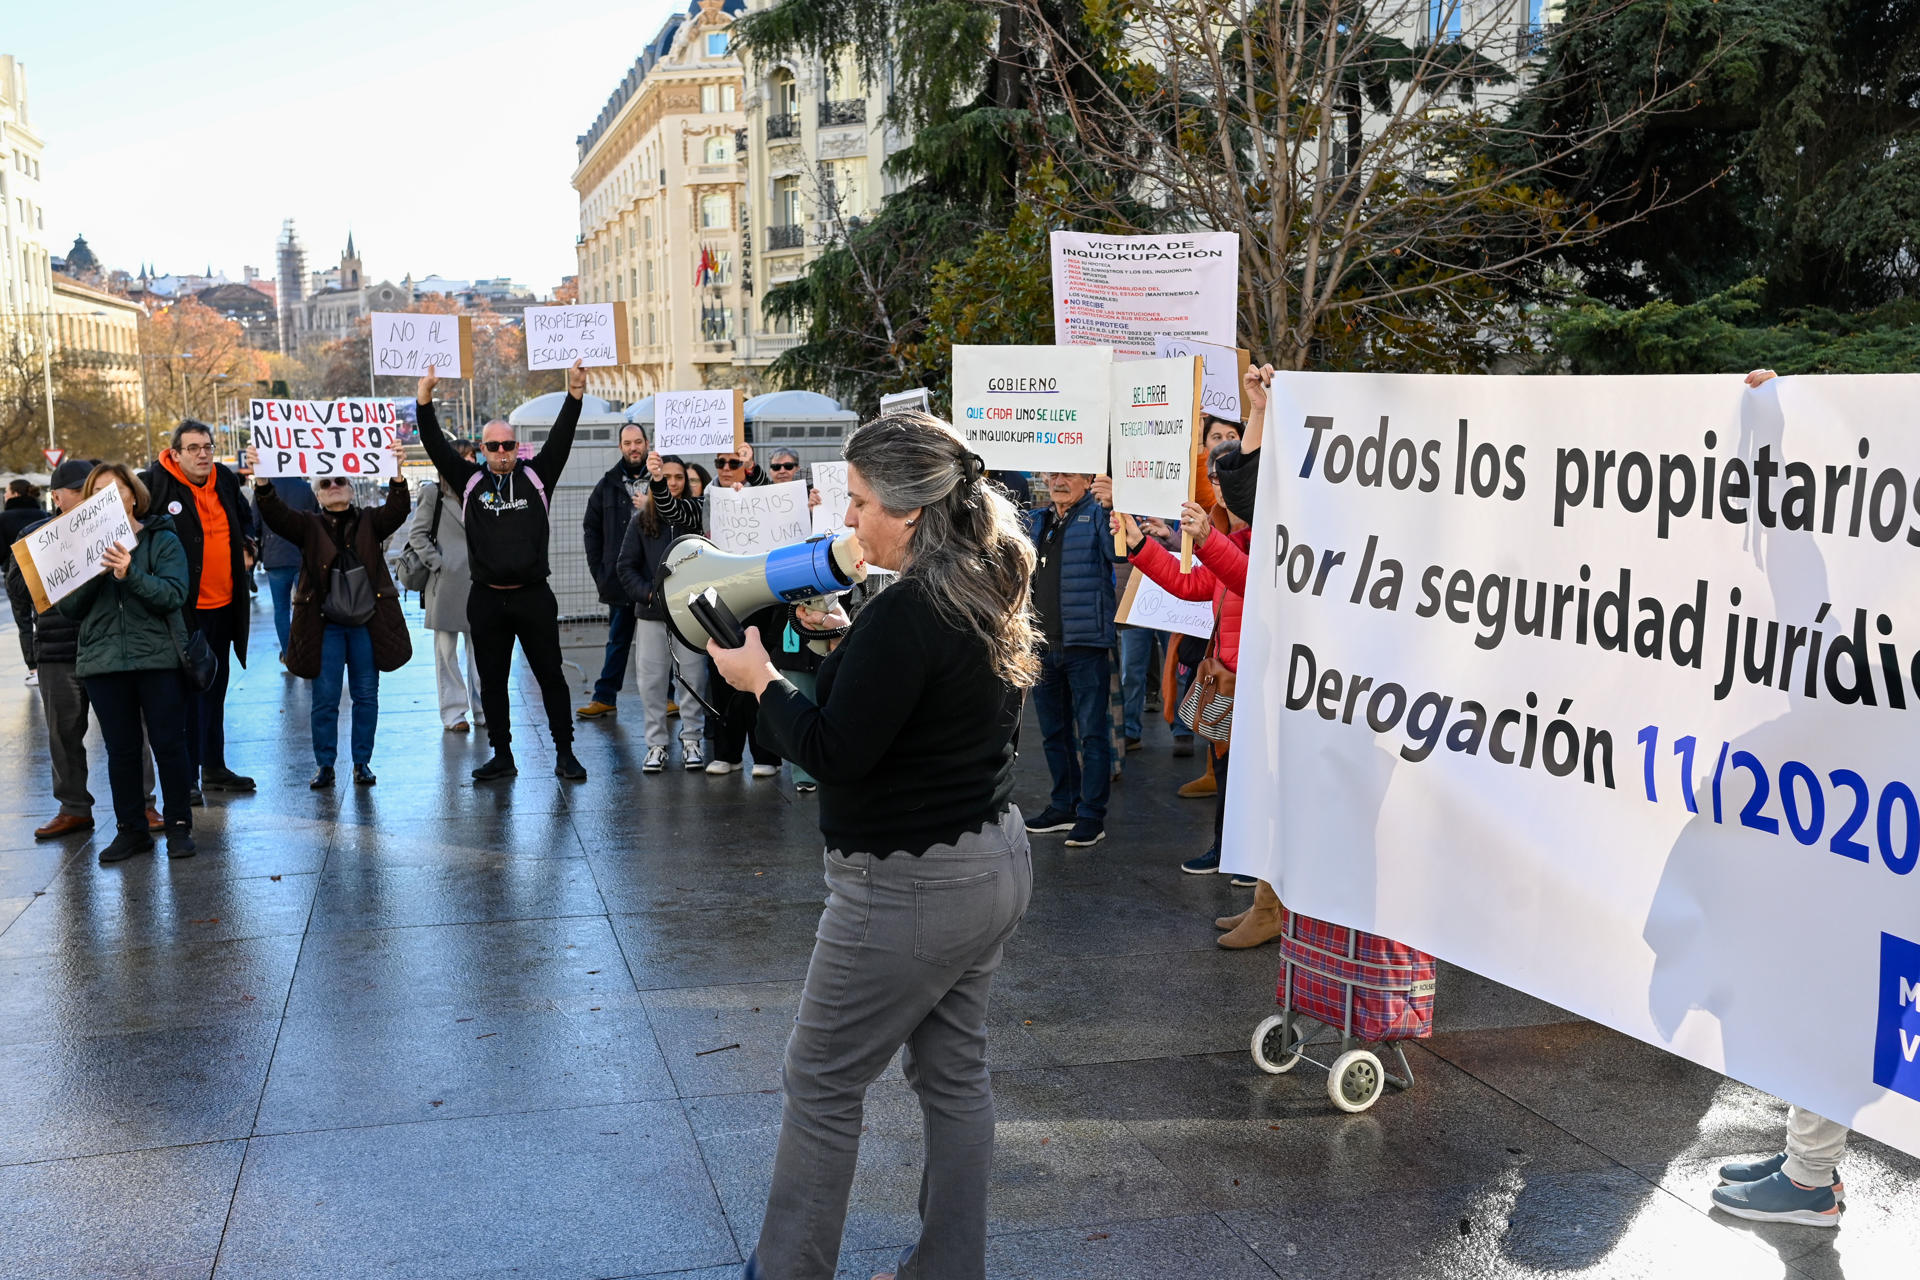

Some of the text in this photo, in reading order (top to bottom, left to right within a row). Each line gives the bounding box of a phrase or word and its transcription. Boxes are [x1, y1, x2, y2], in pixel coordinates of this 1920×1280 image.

[1063, 248, 1222, 261] INQUIOKUPACIÓN
[1088, 241, 1194, 251] VICTIMA DE
[1069, 286, 1106, 295] AYUNTAMIENTO
[389, 320, 449, 344] NO AL
[1095, 320, 1129, 329] PROTEGE
[548, 330, 595, 344] NO ES
[380, 347, 452, 374] RD 11/2020
[533, 343, 616, 365] ESCUDO SOCIAL
[988, 377, 1057, 392] GOBIERNO
[1133, 384, 1167, 404] BELARRA
[252, 401, 396, 425] DEVOLVEDNOS
[665, 396, 726, 417] PROPIEDAD
[966, 407, 1078, 422] QUE CADA UNO SE LLEVE
[665, 415, 711, 431] PRIVADA
[254, 425, 395, 450] NUESTROS
[660, 433, 697, 448] DERECHO
[966, 429, 1083, 445] UN INQUIOKUPA A SU CASA
[277, 451, 381, 475] PISOS
[1299, 416, 1441, 492] Todos
[1455, 418, 1526, 501] los
[1166, 462, 1181, 480] CASA
[38, 526, 59, 552] SIN
[720, 521, 804, 549] POR UNA
[46, 560, 81, 592] NADIE
[1140, 595, 1159, 611] NO
[1275, 524, 1346, 596] Por
[1350, 535, 1404, 612] la
[1415, 564, 1709, 669] seguridad
[1285, 643, 1920, 875] Derogación 11/2020
